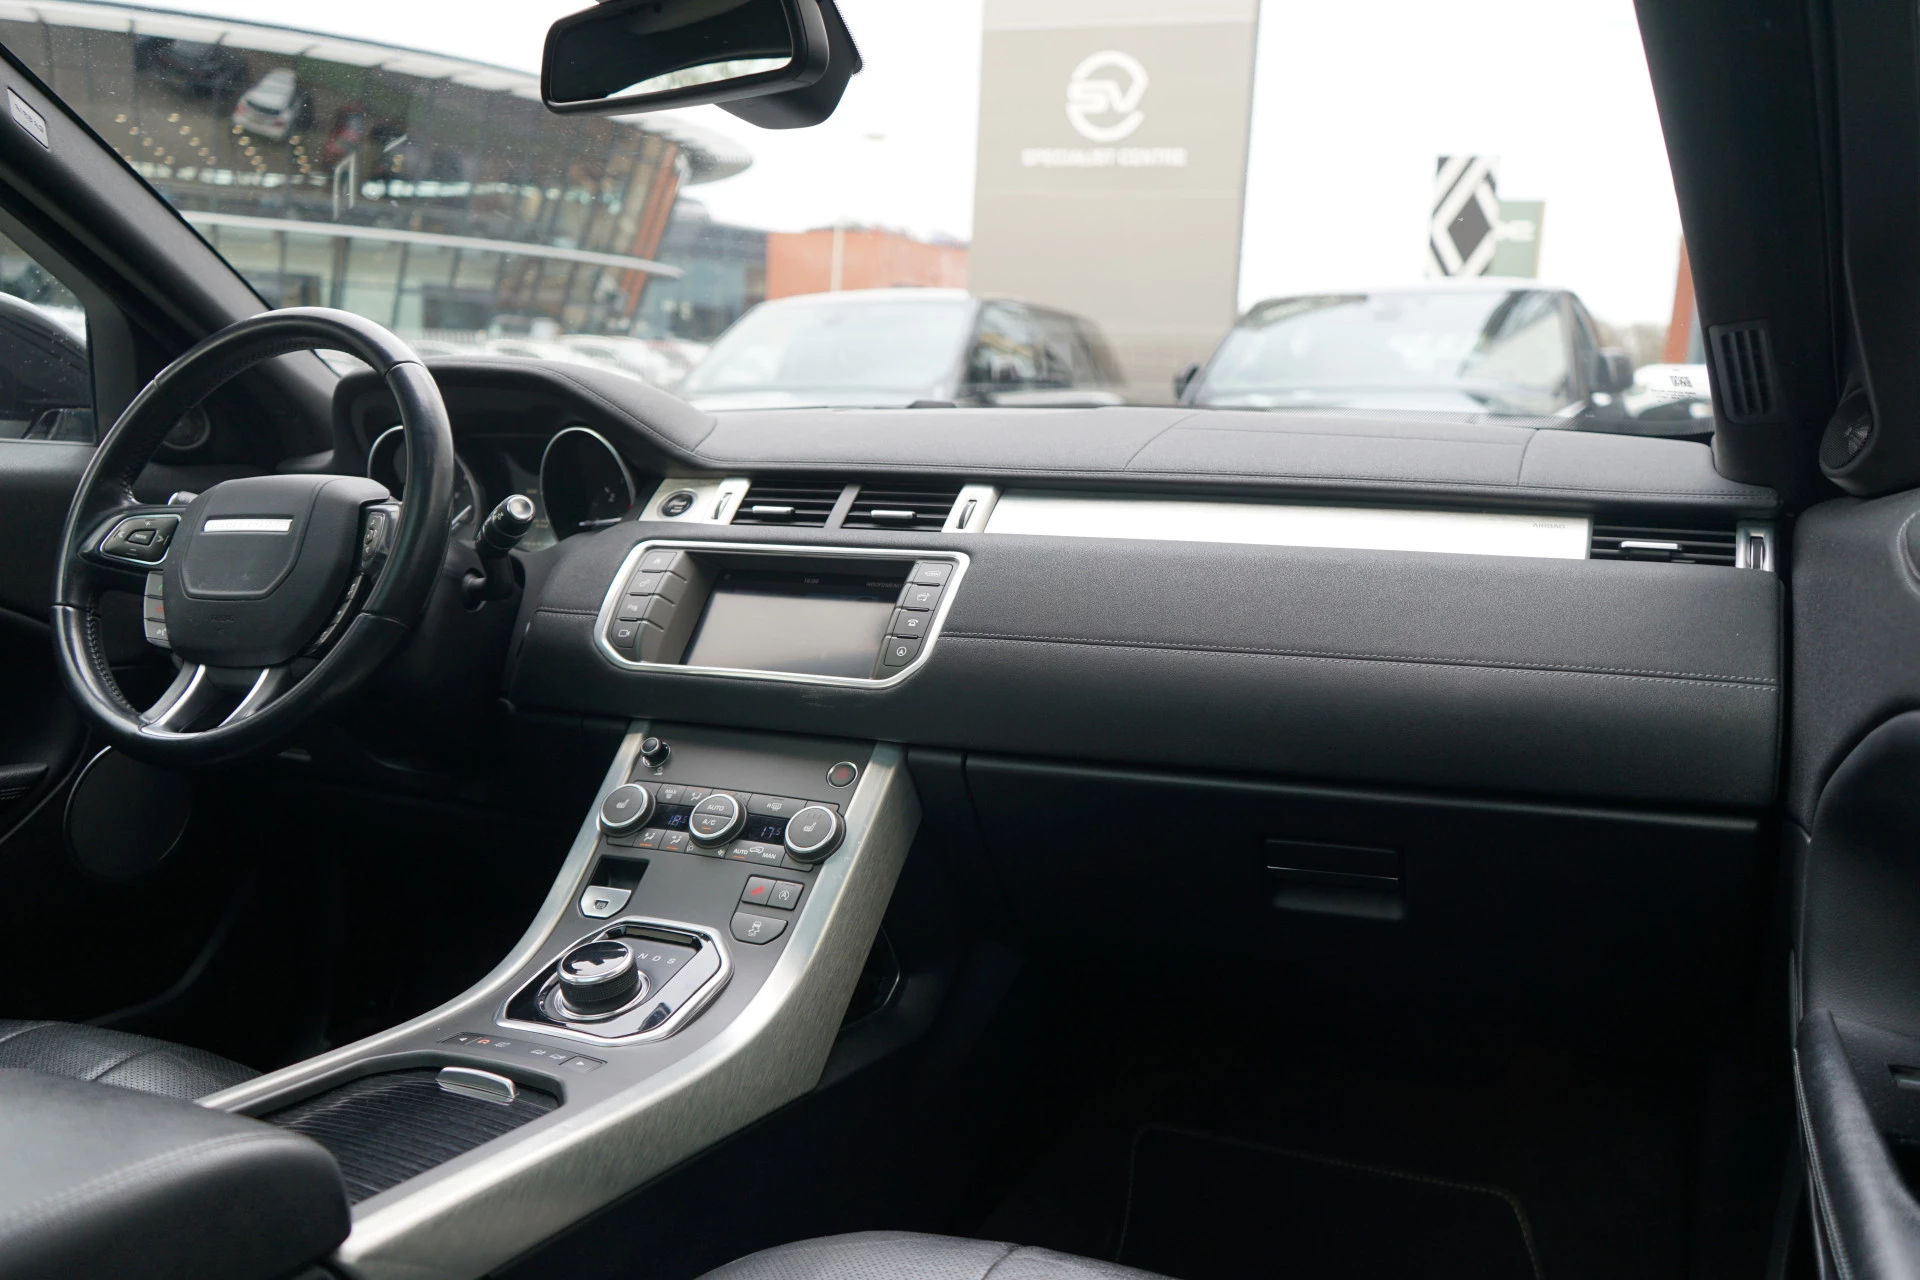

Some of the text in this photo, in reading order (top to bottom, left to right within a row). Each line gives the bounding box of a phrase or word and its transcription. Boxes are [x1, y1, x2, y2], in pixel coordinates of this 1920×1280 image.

[706, 804, 724, 812] AUTO
[701, 818, 716, 826] A/C
[733, 848, 749, 856] AUTO
[762, 852, 777, 860] MAN
